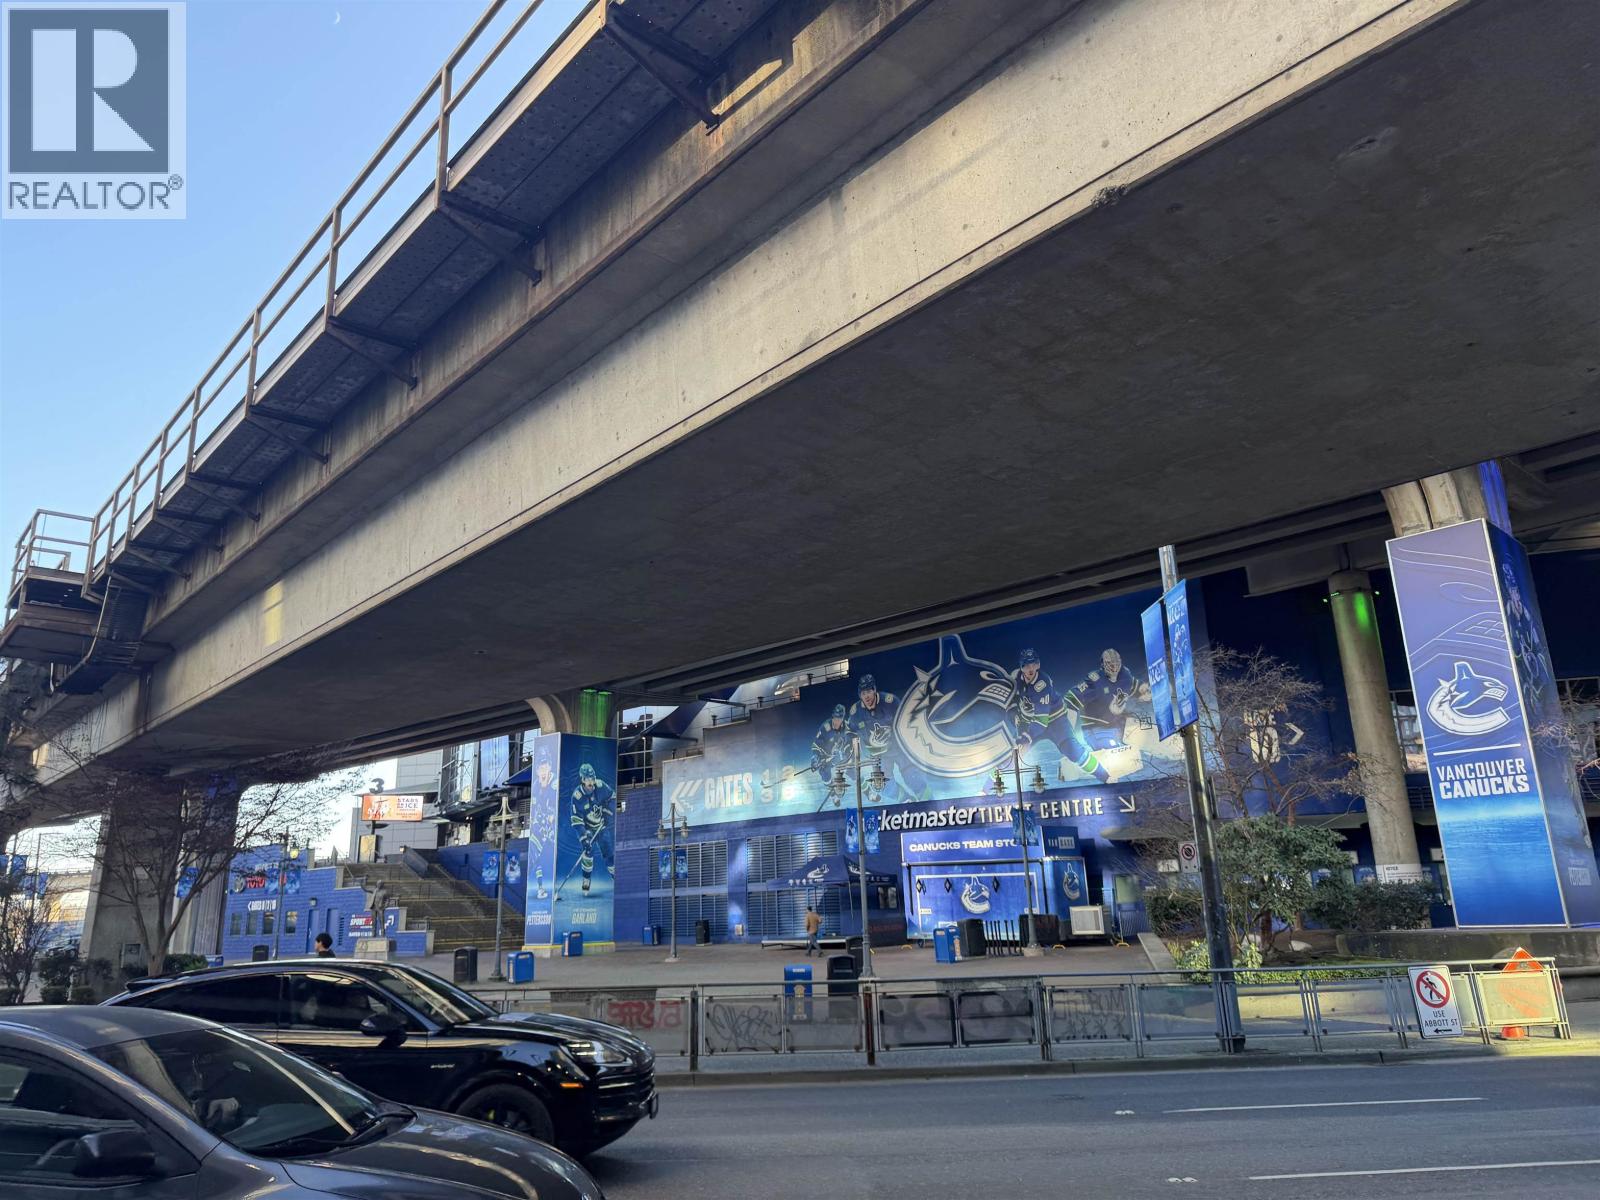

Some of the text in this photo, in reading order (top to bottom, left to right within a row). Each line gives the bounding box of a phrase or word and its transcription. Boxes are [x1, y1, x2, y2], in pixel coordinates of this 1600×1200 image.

[1436, 758, 1527, 781] VANCOUVER
[369, 777, 385, 794] 3
[704, 772, 754, 809] GATES
[1439, 774, 1530, 799] CANUCKS
[878, 797, 1104, 832] ketmaster TICK CENTRE
[909, 841, 961, 853] CANUCKS
[962, 839, 997, 849] TEAM
[1424, 1018, 1458, 1028] ABBOTT ST
[1432, 1009, 1446, 1018] USE
